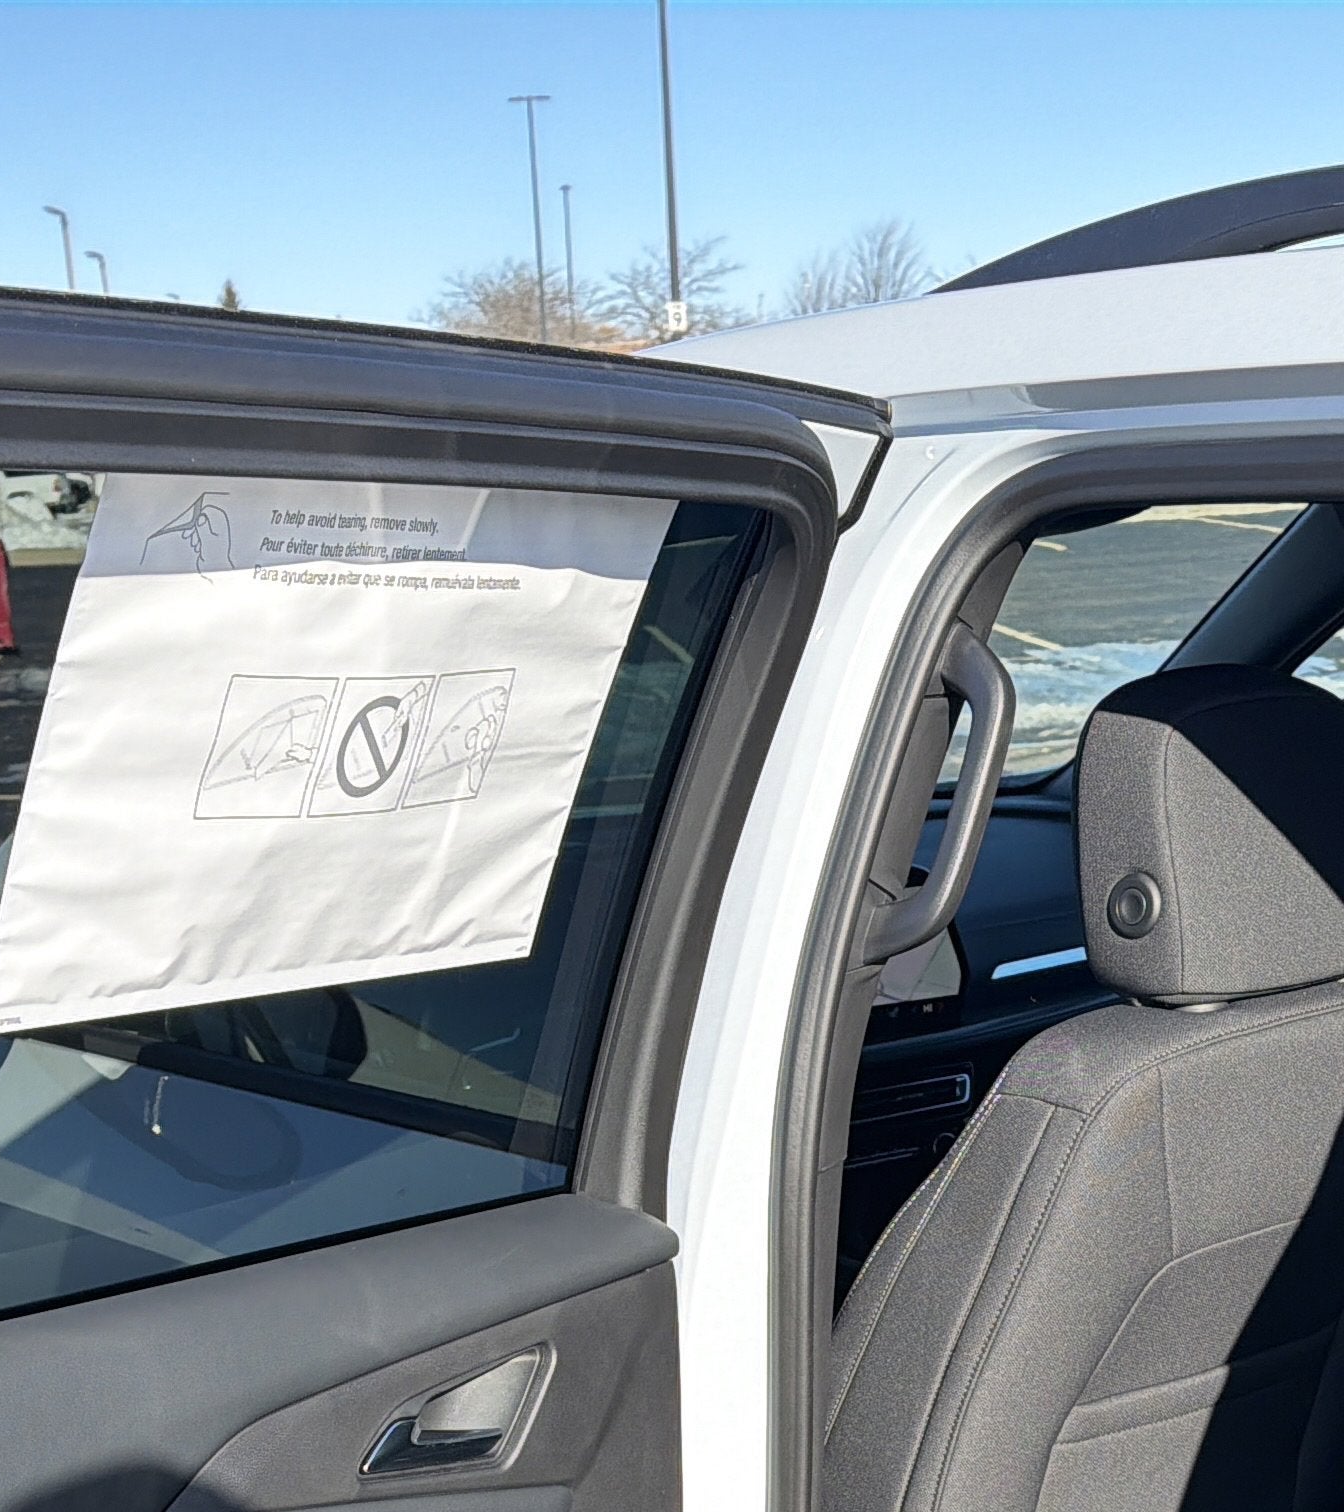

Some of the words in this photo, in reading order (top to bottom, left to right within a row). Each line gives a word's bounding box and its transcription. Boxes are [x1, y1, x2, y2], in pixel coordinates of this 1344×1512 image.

[672, 311, 682, 327] 9
[271, 509, 282, 525] To
[283, 509, 305, 529] help
[308, 513, 338, 529] avoid
[338, 514, 368, 532] tearing,
[369, 517, 406, 531] remove
[408, 516, 439, 536] slowly.
[260, 536, 285, 552] Pour
[286, 537, 318, 556] éviter
[320, 541, 344, 558] toute
[345, 541, 389, 561] déchirure,
[392, 544, 422, 561] retirer
[253, 563, 278, 582] Para
[281, 569, 329, 586] ayudarse
[363, 574, 382, 589] que
[383, 574, 396, 587] se
